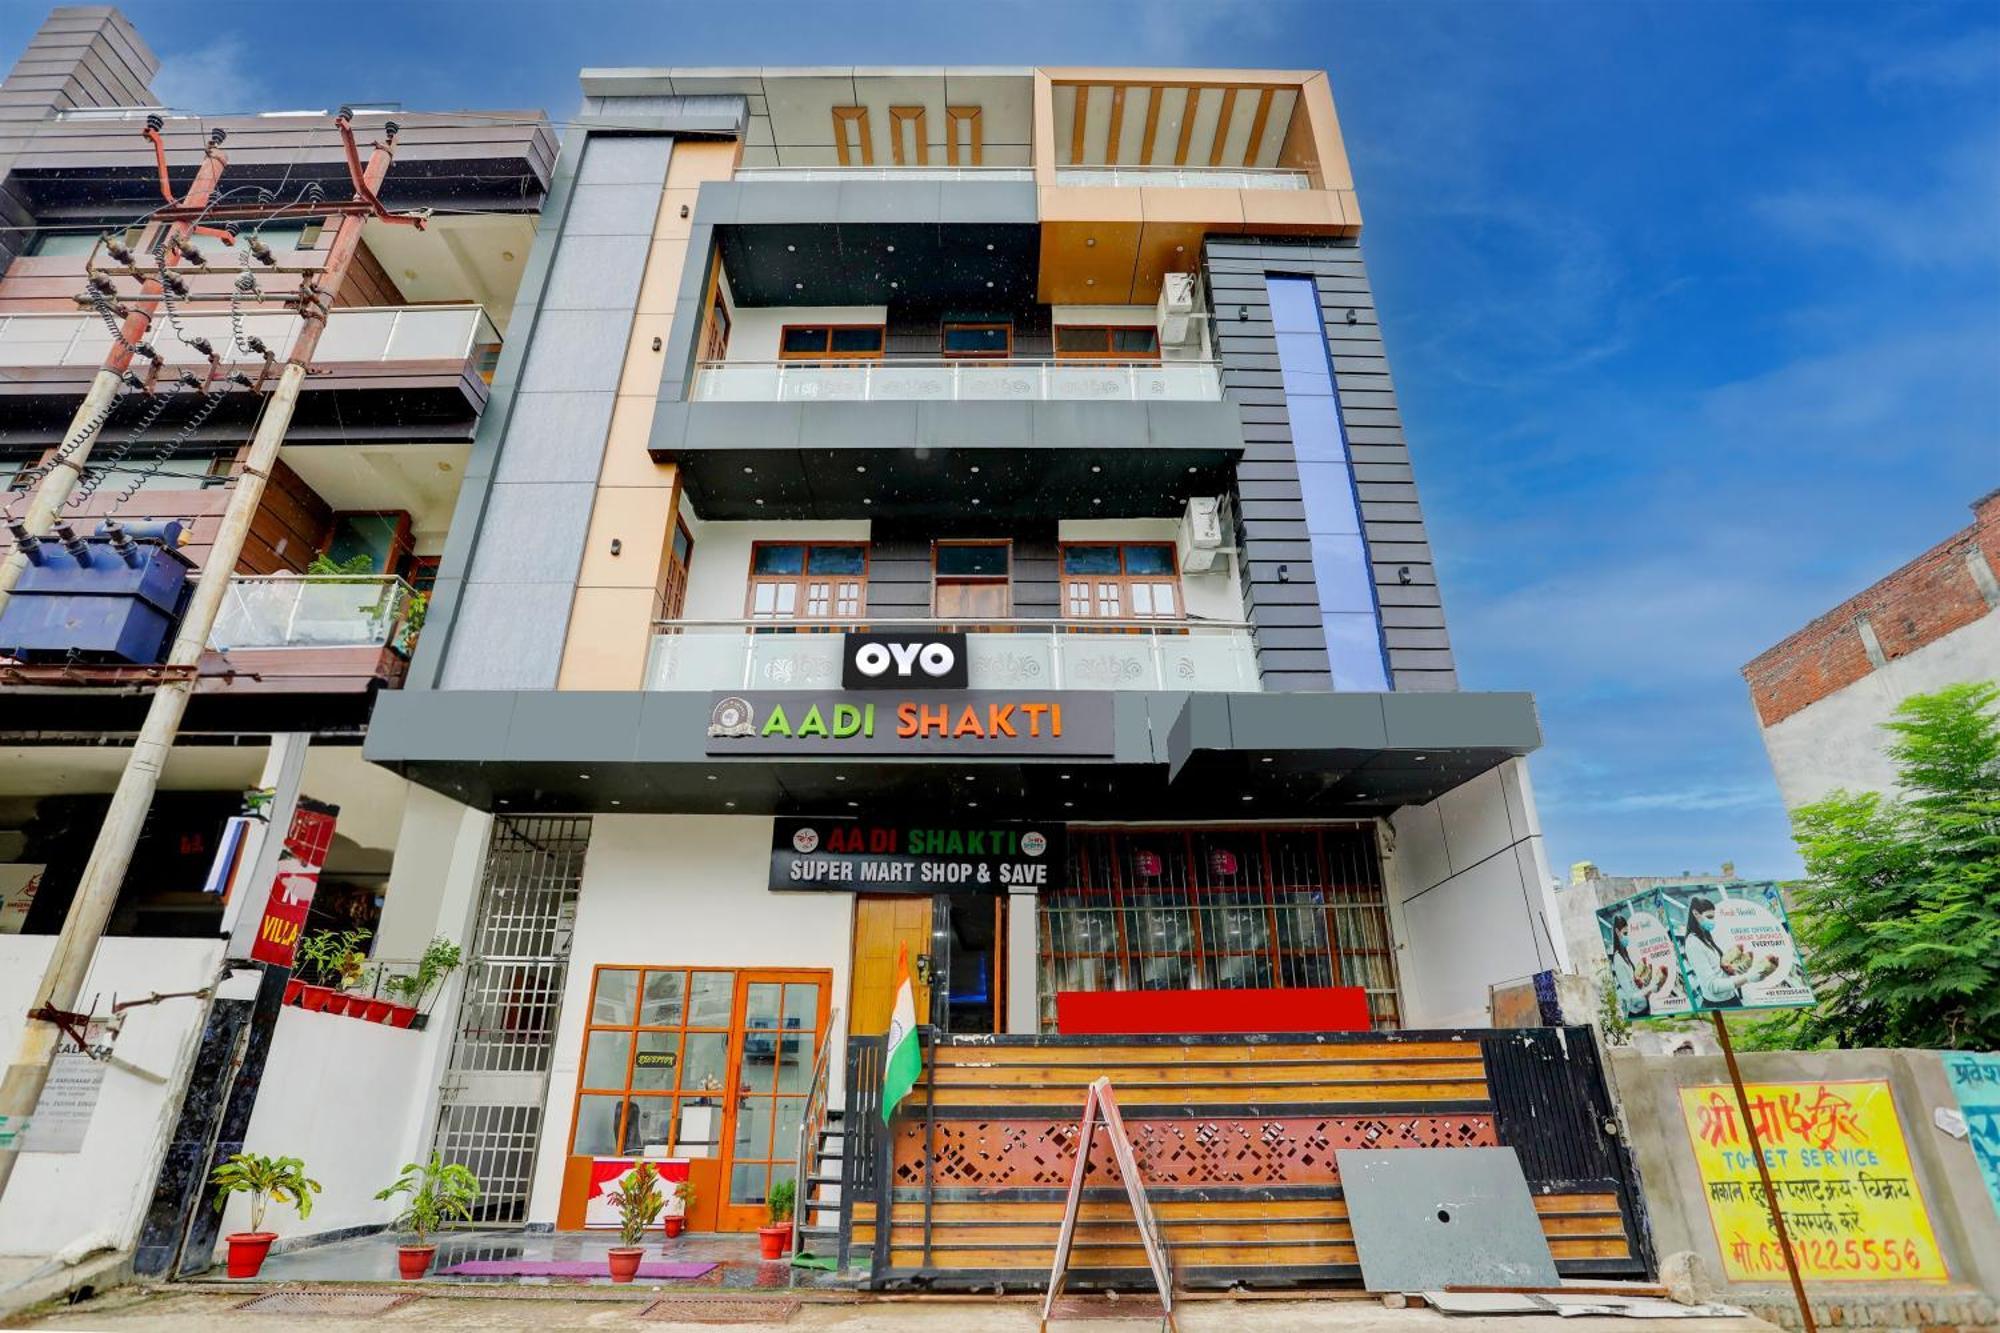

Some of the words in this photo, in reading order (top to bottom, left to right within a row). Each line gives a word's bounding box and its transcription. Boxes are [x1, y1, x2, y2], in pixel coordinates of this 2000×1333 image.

[855, 642, 955, 677] OYO
[761, 703, 875, 738] AADI
[896, 703, 1062, 740] SHAKTI
[827, 827, 897, 854] AADI
[909, 829, 1017, 857] SHAKTI
[790, 860, 853, 882] SUPER
[860, 861, 915, 883] MART
[920, 862, 973, 884] SHOP
[976, 866, 991, 884] &
[999, 863, 1048, 885] SAVE
[262, 915, 300, 946] VILLA
[1697, 1091, 1739, 1148] श्री
[1800, 1148, 1879, 1168] SERVICE
